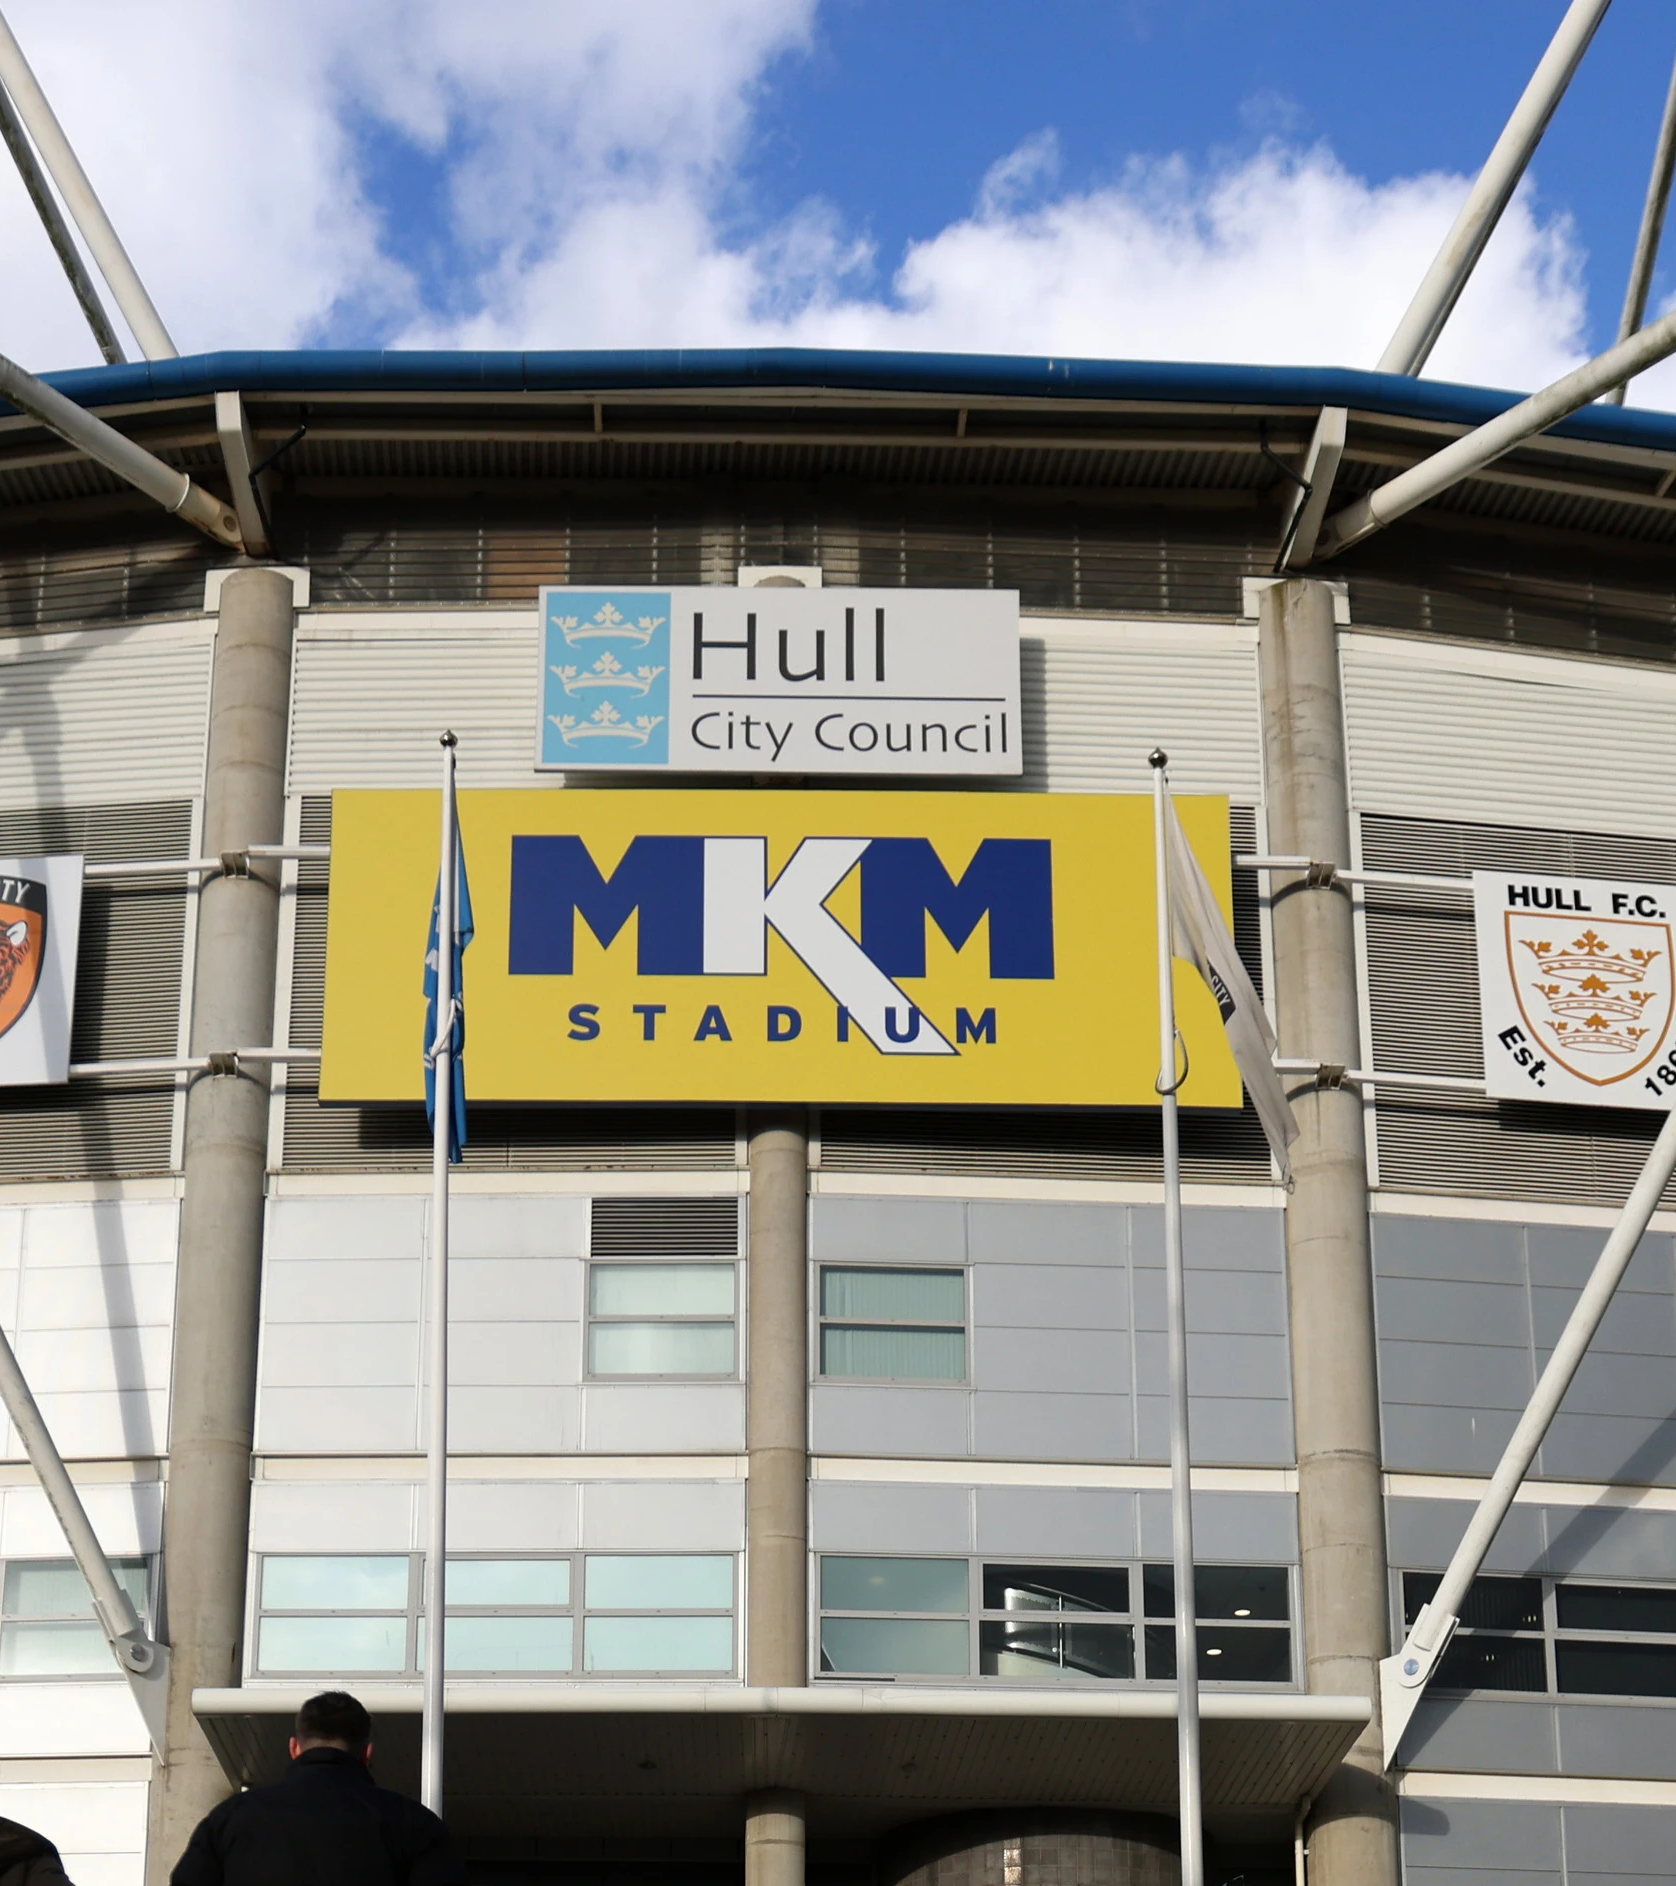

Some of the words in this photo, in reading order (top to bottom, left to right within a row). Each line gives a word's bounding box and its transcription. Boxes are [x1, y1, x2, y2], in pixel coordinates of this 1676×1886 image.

[692, 607, 887, 683] Hull
[691, 711, 795, 762] City
[814, 711, 1010, 754] Council
[1507, 884, 1592, 913] HULL
[1611, 892, 1667, 919] F.C.
[508, 834, 1055, 1056] MKM
[567, 1003, 998, 1046] STADIUM
[1498, 1024, 1548, 1089] Est.
